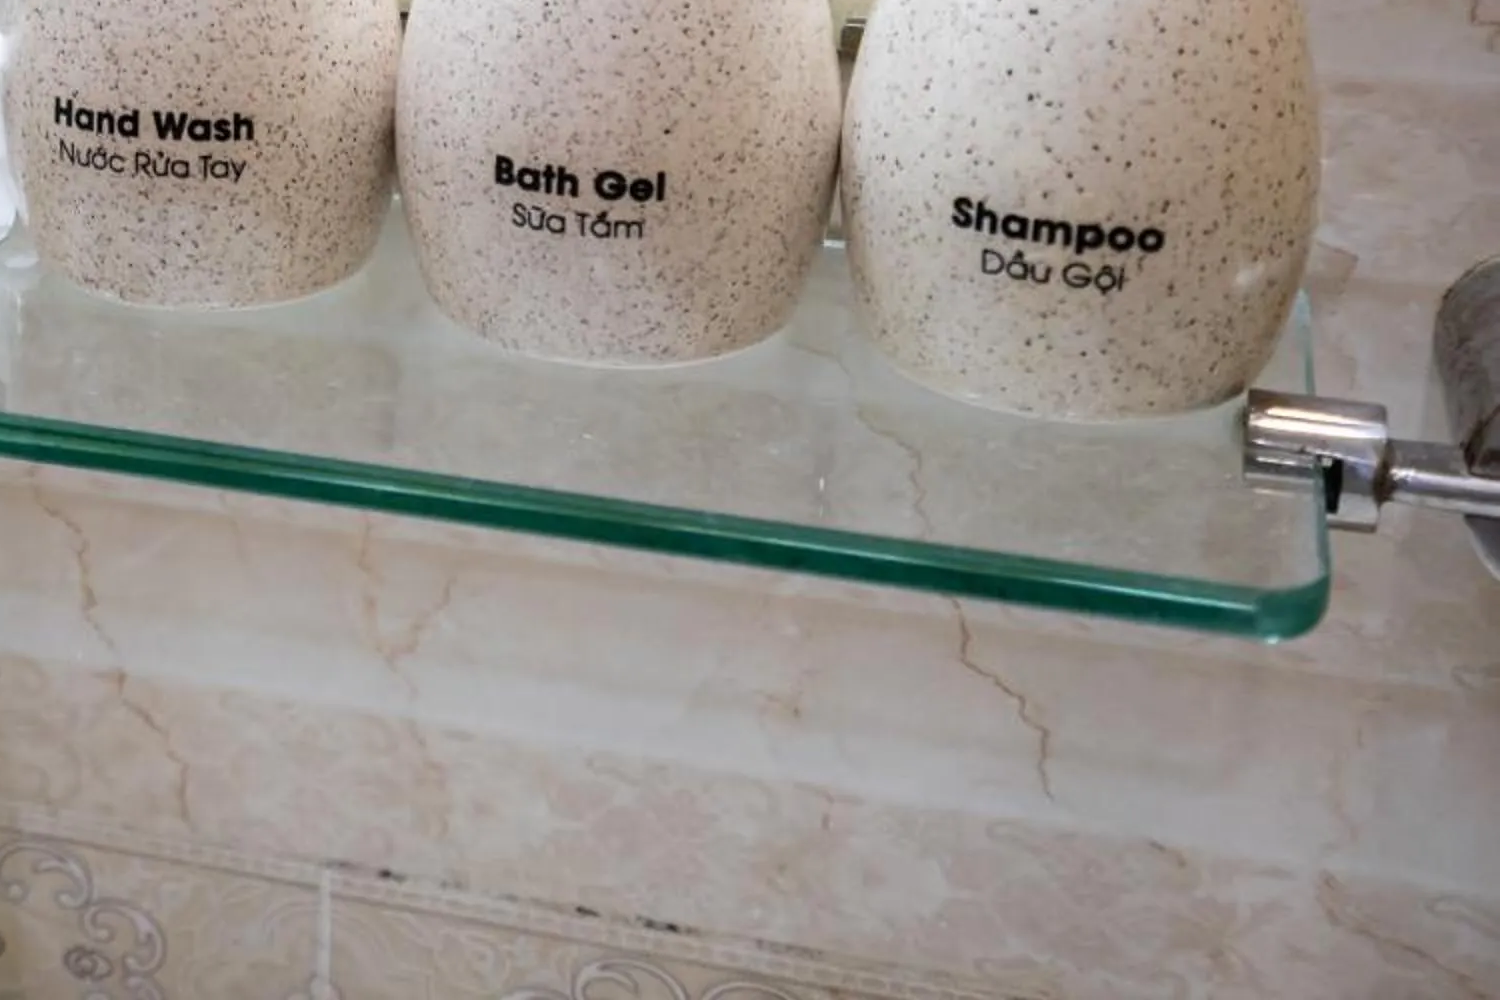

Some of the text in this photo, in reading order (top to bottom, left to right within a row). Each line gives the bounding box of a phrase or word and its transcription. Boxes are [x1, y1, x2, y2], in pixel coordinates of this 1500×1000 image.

[54, 96, 255, 142] Hand Wash
[198, 154, 247, 184] Tay
[495, 154, 667, 202] Bath Gel
[952, 196, 1166, 255] Shampoo
[1062, 261, 1126, 296] Gội
